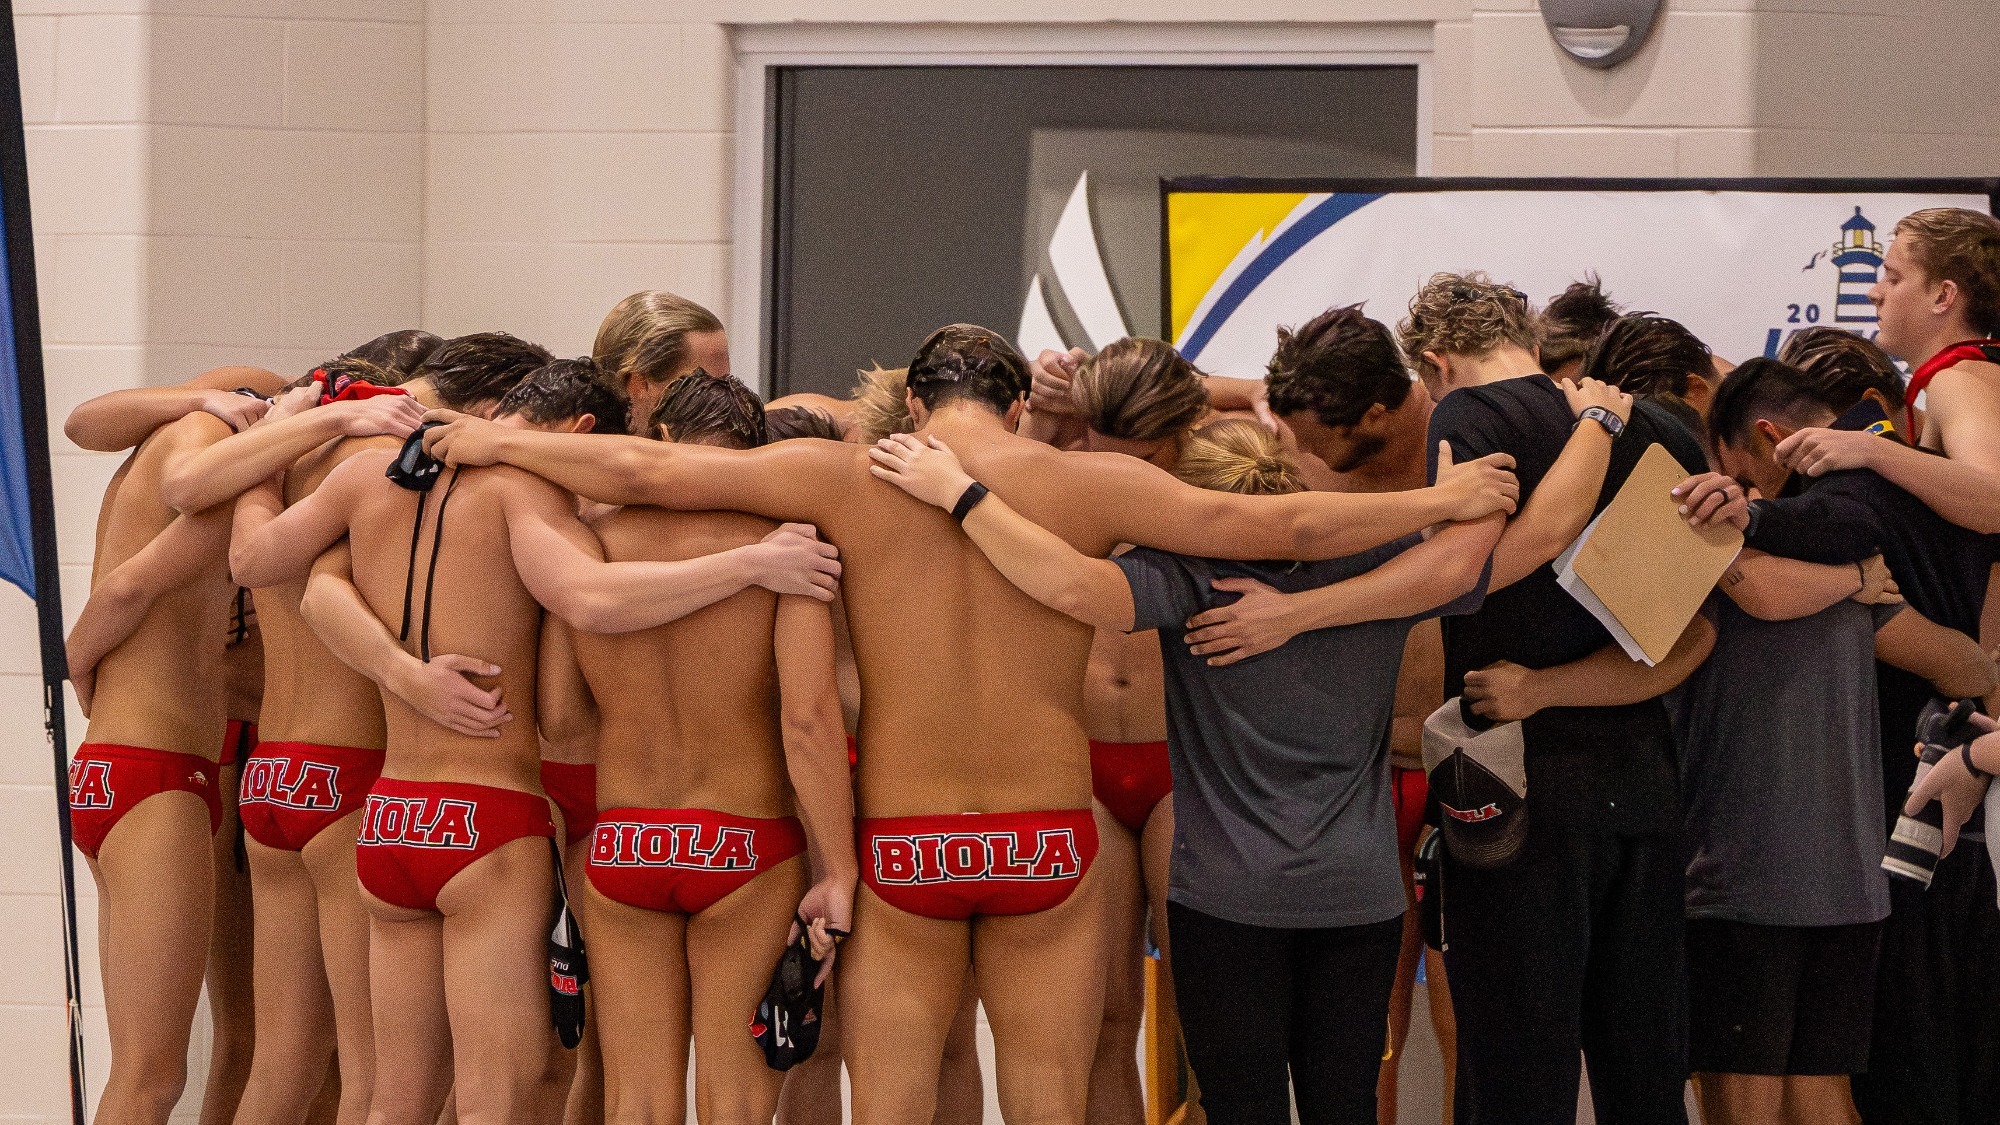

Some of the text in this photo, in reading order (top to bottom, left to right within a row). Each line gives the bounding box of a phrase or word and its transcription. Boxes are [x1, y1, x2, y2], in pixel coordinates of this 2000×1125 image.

[68, 759, 115, 810] LA
[239, 757, 343, 812] IOLA
[590, 821, 759, 871] BIOLA
[872, 828, 1081, 886] BIOLA
